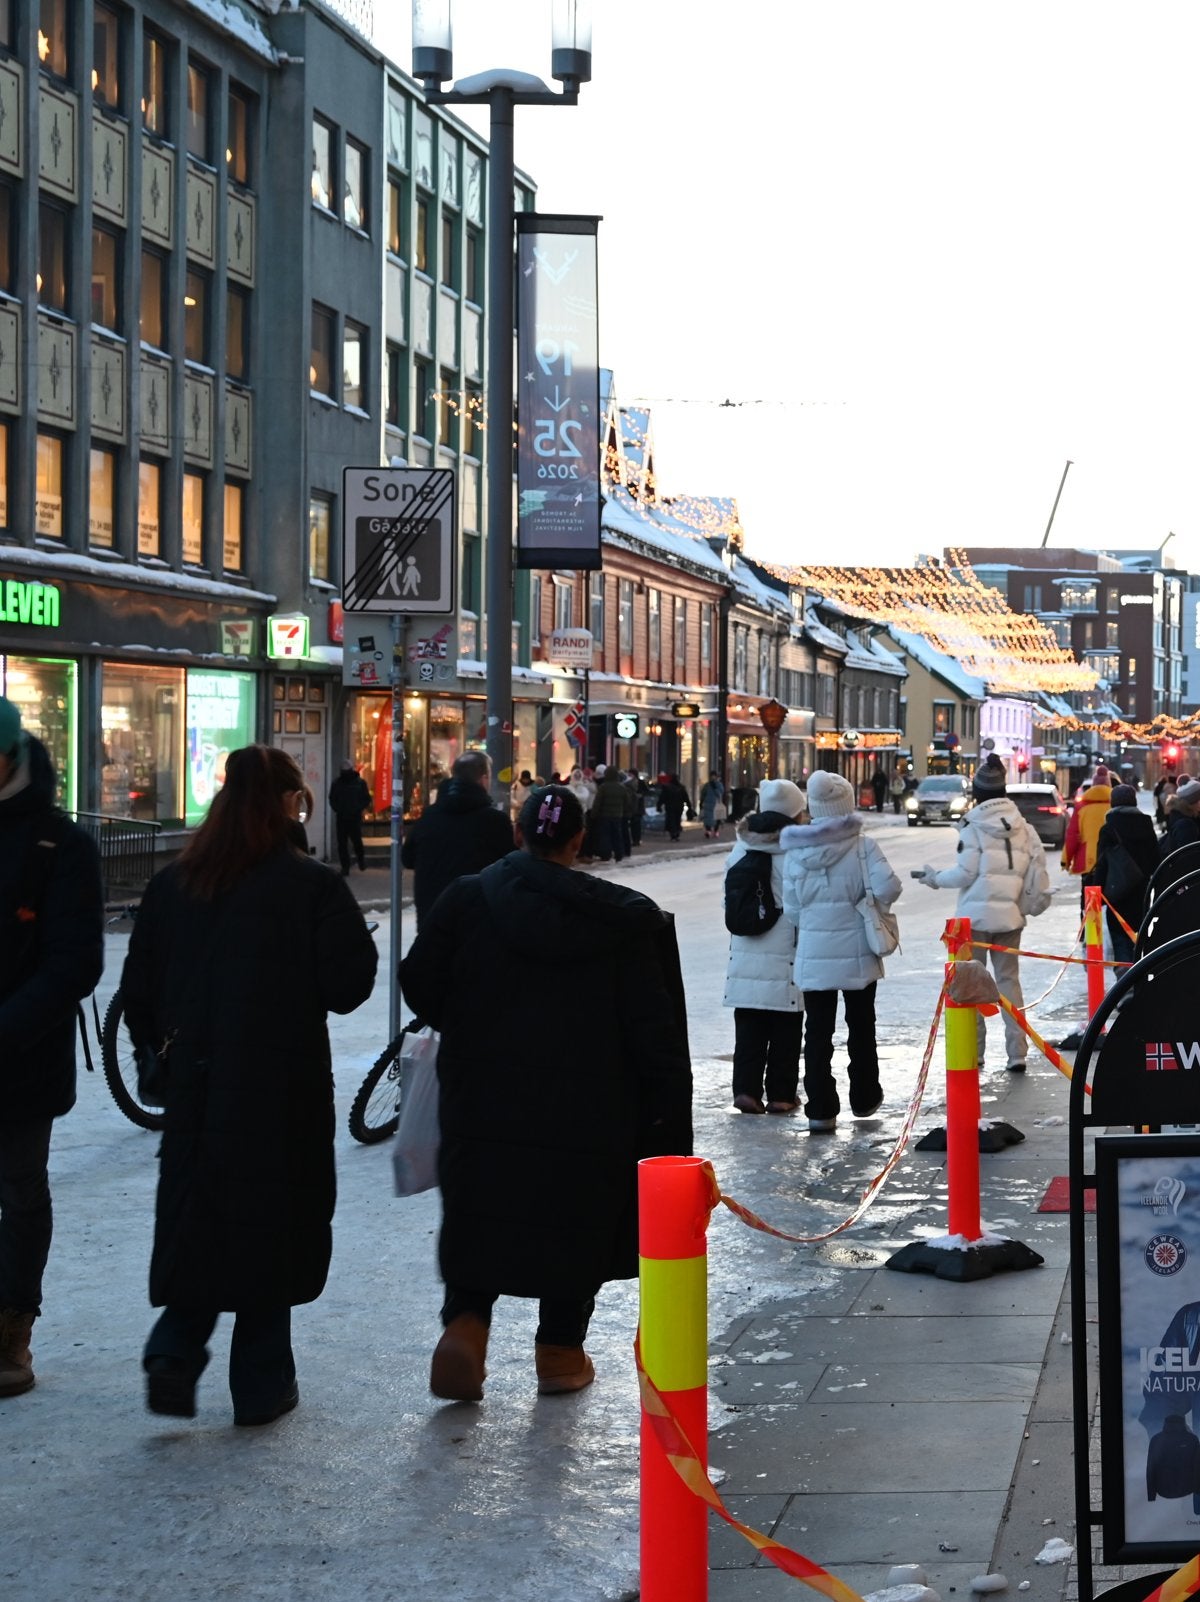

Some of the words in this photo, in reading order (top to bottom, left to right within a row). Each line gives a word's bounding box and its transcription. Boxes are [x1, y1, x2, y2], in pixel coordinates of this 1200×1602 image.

[363, 476, 436, 503] Sone
[553, 637, 590, 649] RANDI
[1146, 1235, 1184, 1256] ICEWEAR
